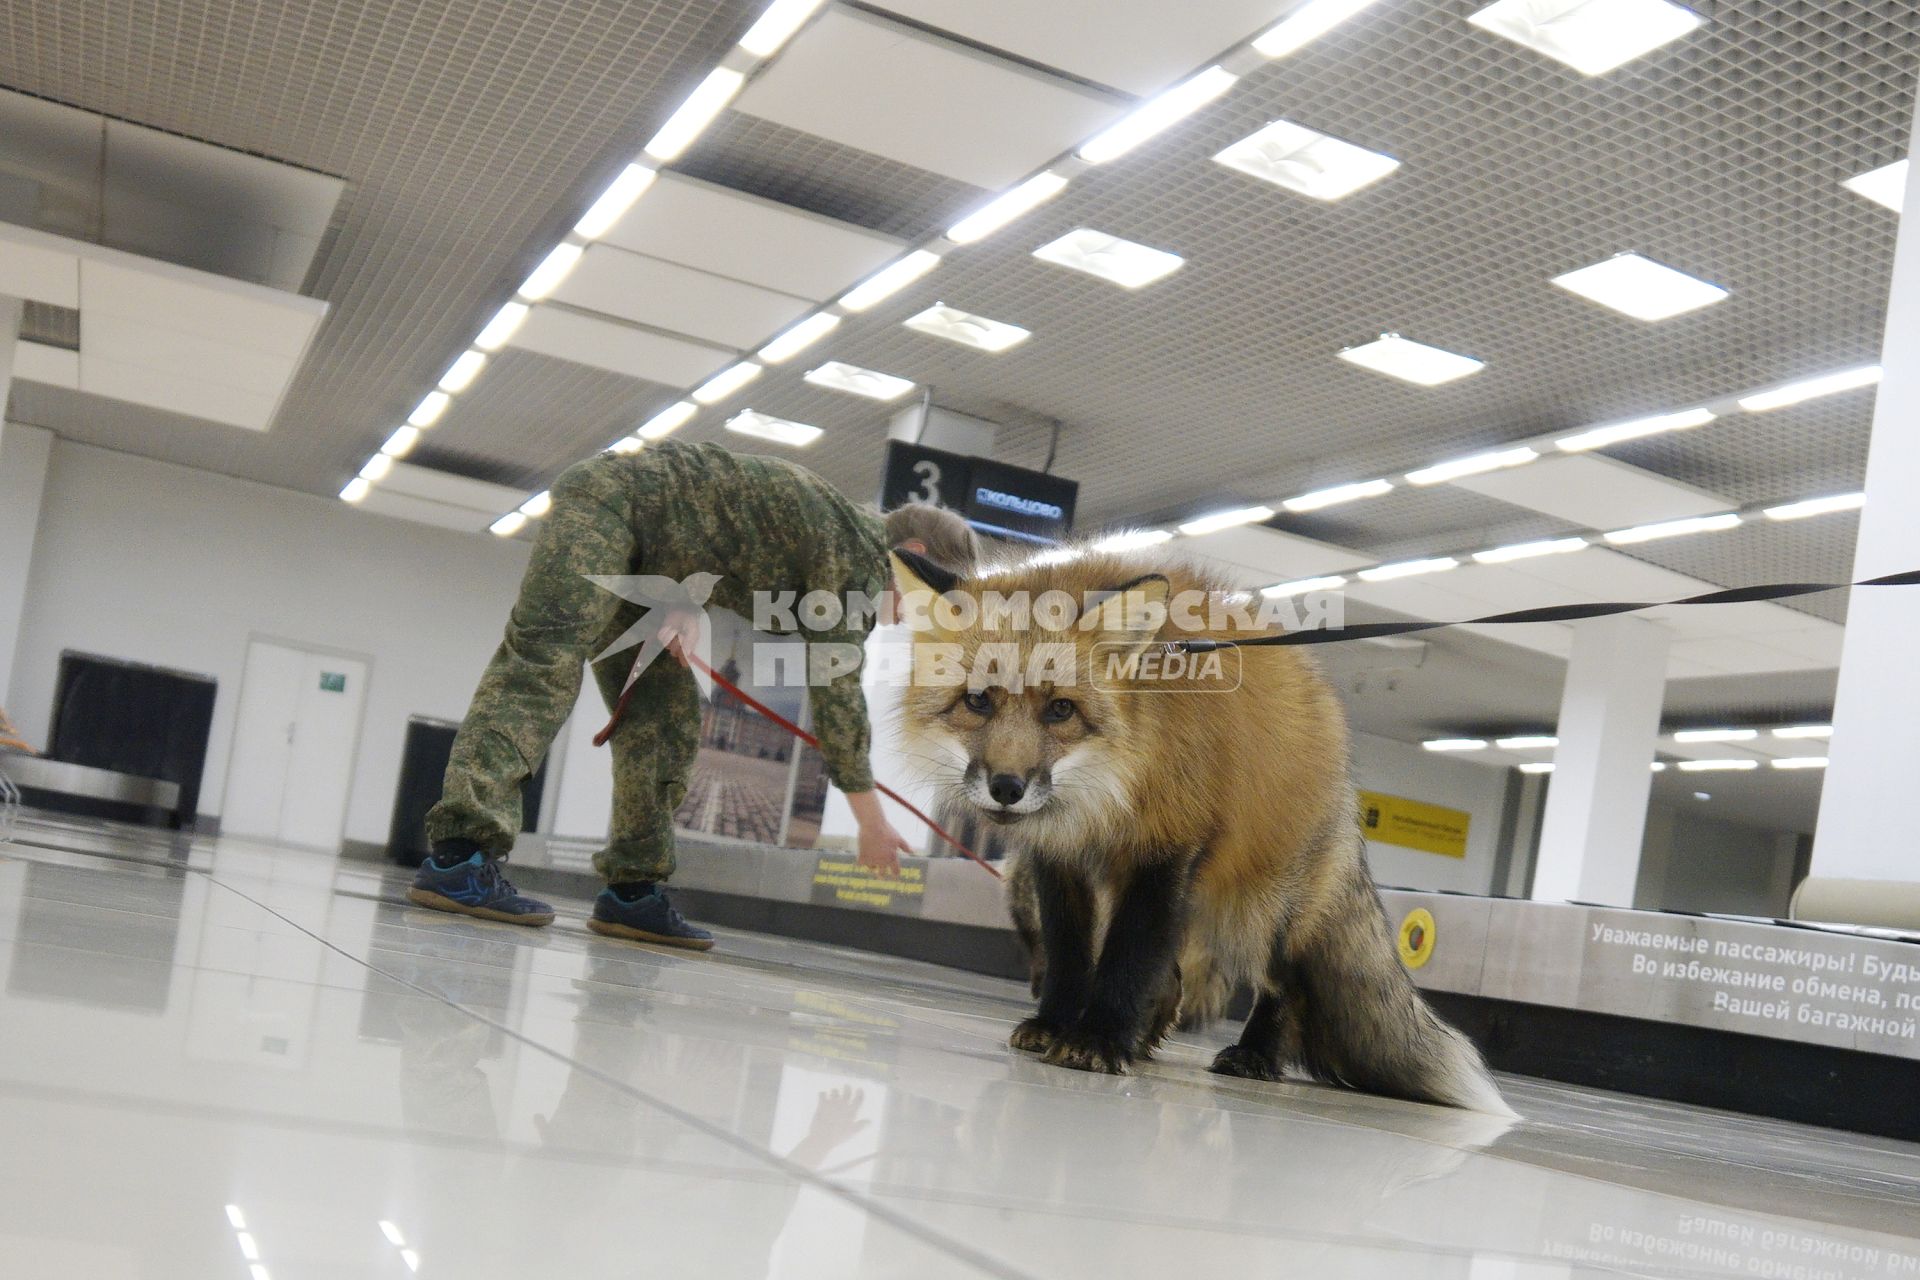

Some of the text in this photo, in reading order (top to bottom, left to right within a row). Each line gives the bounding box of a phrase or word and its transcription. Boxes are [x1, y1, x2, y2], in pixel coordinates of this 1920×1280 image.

[907, 460, 942, 507] 3
[1592, 923, 1709, 954] Уважаемые
[1714, 940, 1855, 973] пассажиры!
[1632, 954, 1657, 975] Во
[1663, 960, 1786, 992] избежание
[1792, 976, 1888, 1010] обмена,
[1713, 990, 1916, 1039] Вашей багажной
